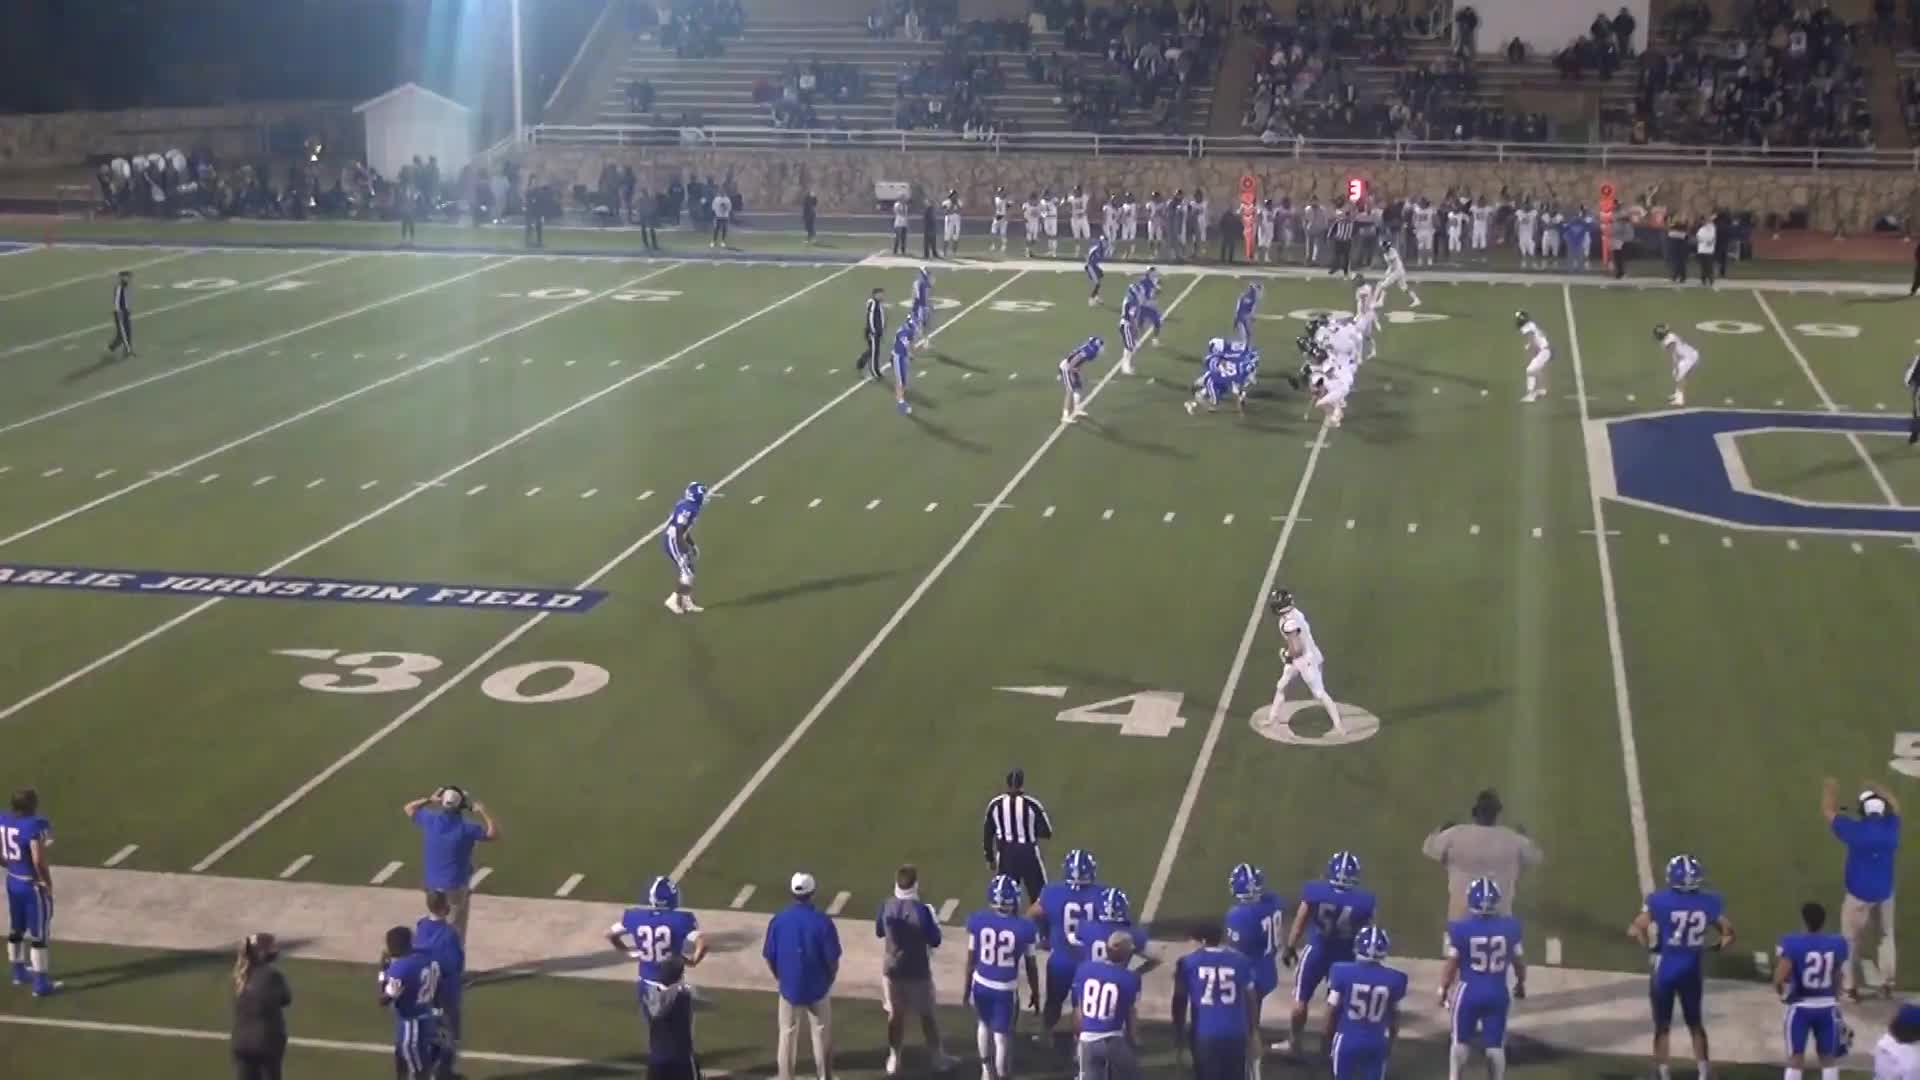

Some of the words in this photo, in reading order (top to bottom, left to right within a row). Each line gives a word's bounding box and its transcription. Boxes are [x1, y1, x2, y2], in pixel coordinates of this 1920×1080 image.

[140, 576, 418, 600] JOHNSTON
[428, 588, 583, 608] FIELD
[0, 824, 21, 860] 15
[637, 925, 672, 962] 32
[979, 927, 1016, 967] 82
[1667, 910, 1707, 947] 72
[1470, 935, 1507, 973] 52
[1802, 951, 1835, 989] 21
[1082, 978, 1119, 1020] 80
[1198, 966, 1236, 1005] 75
[1347, 983, 1390, 1022] 50
